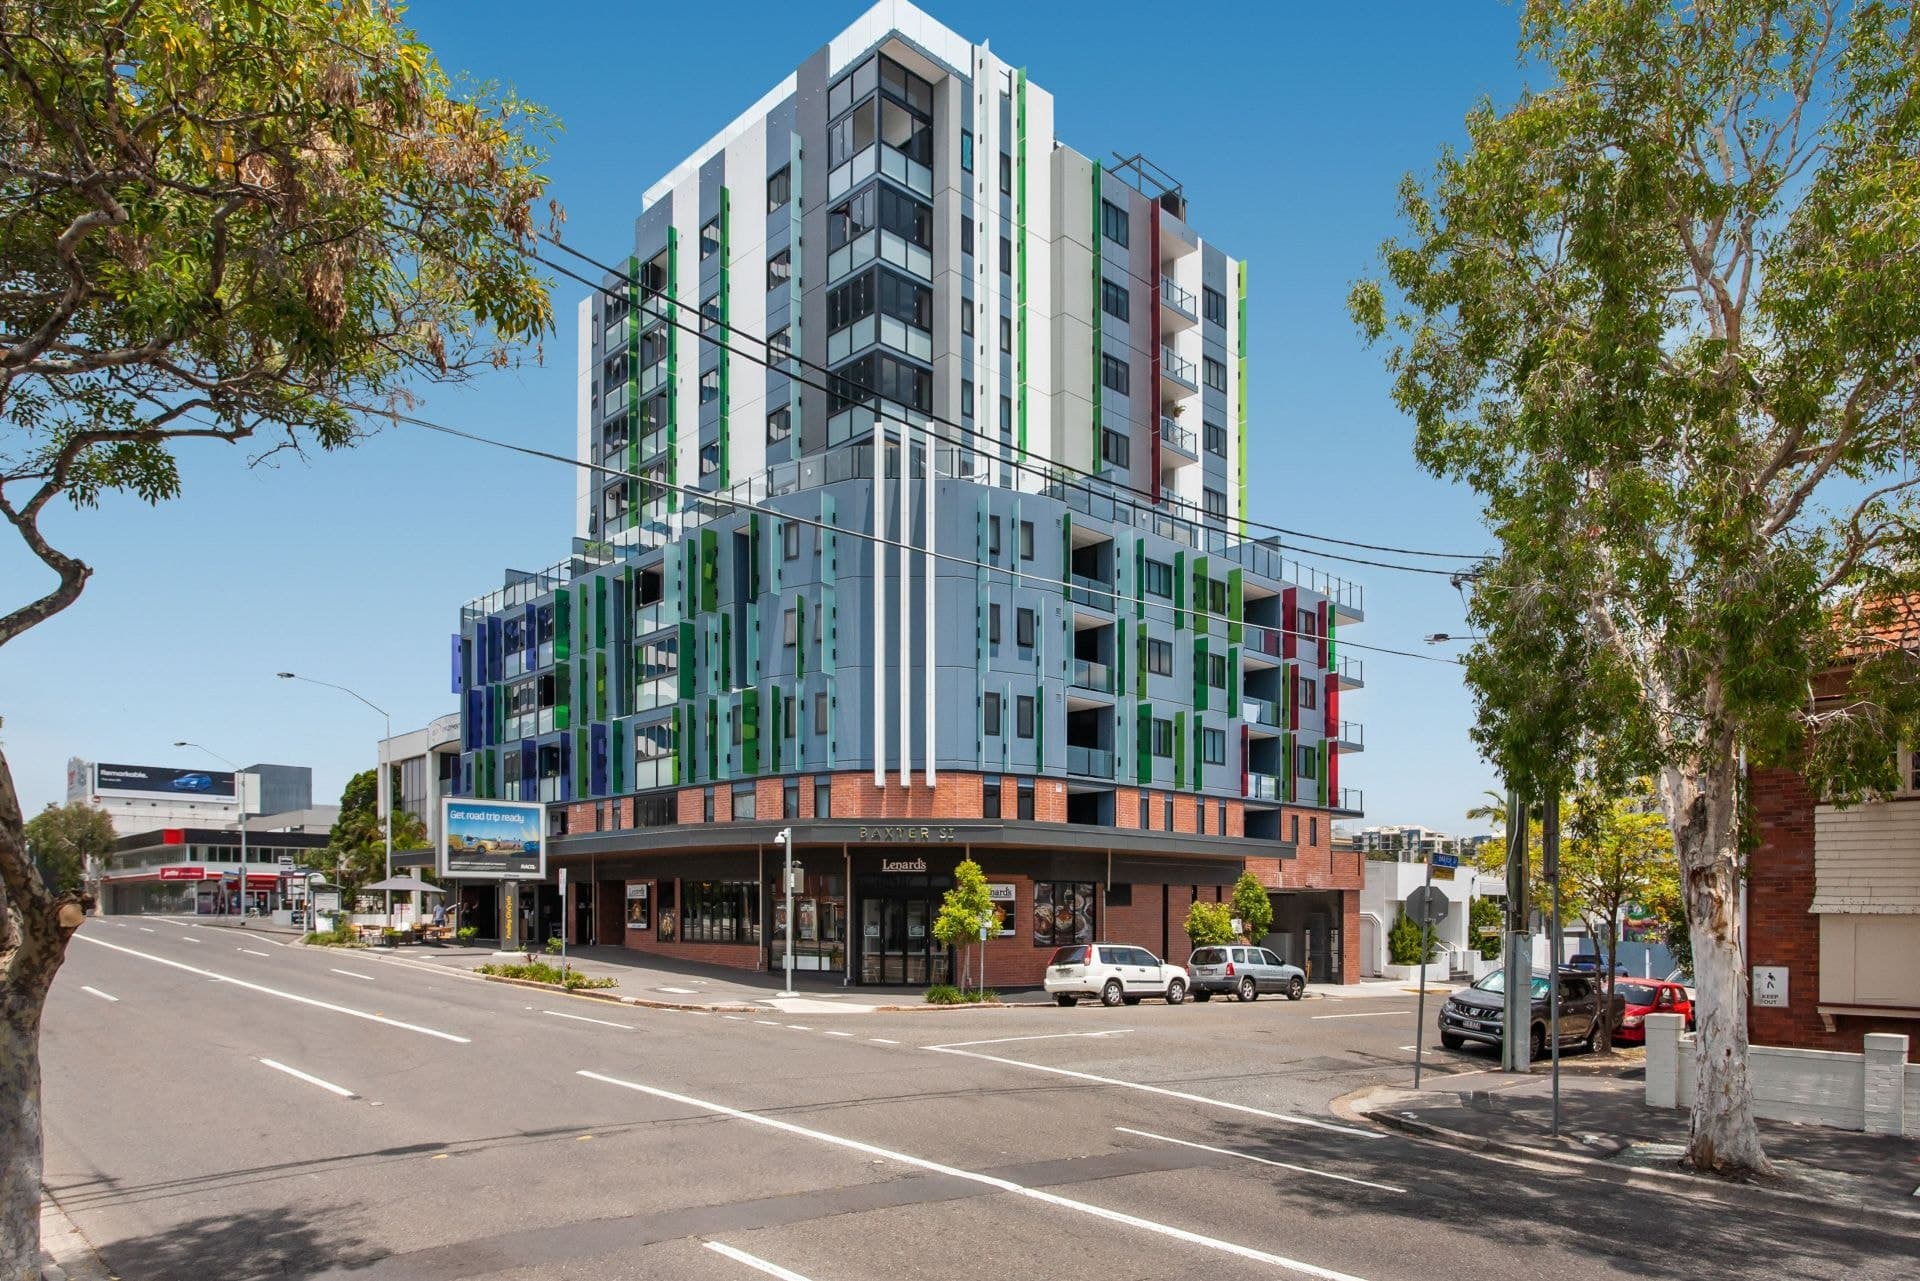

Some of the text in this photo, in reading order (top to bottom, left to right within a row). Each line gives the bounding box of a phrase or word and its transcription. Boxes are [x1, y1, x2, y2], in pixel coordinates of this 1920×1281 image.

[450, 810, 525, 824] Get road trip ready
[859, 827, 929, 839] BAXTER
[882, 858, 927, 872] Lenard's
